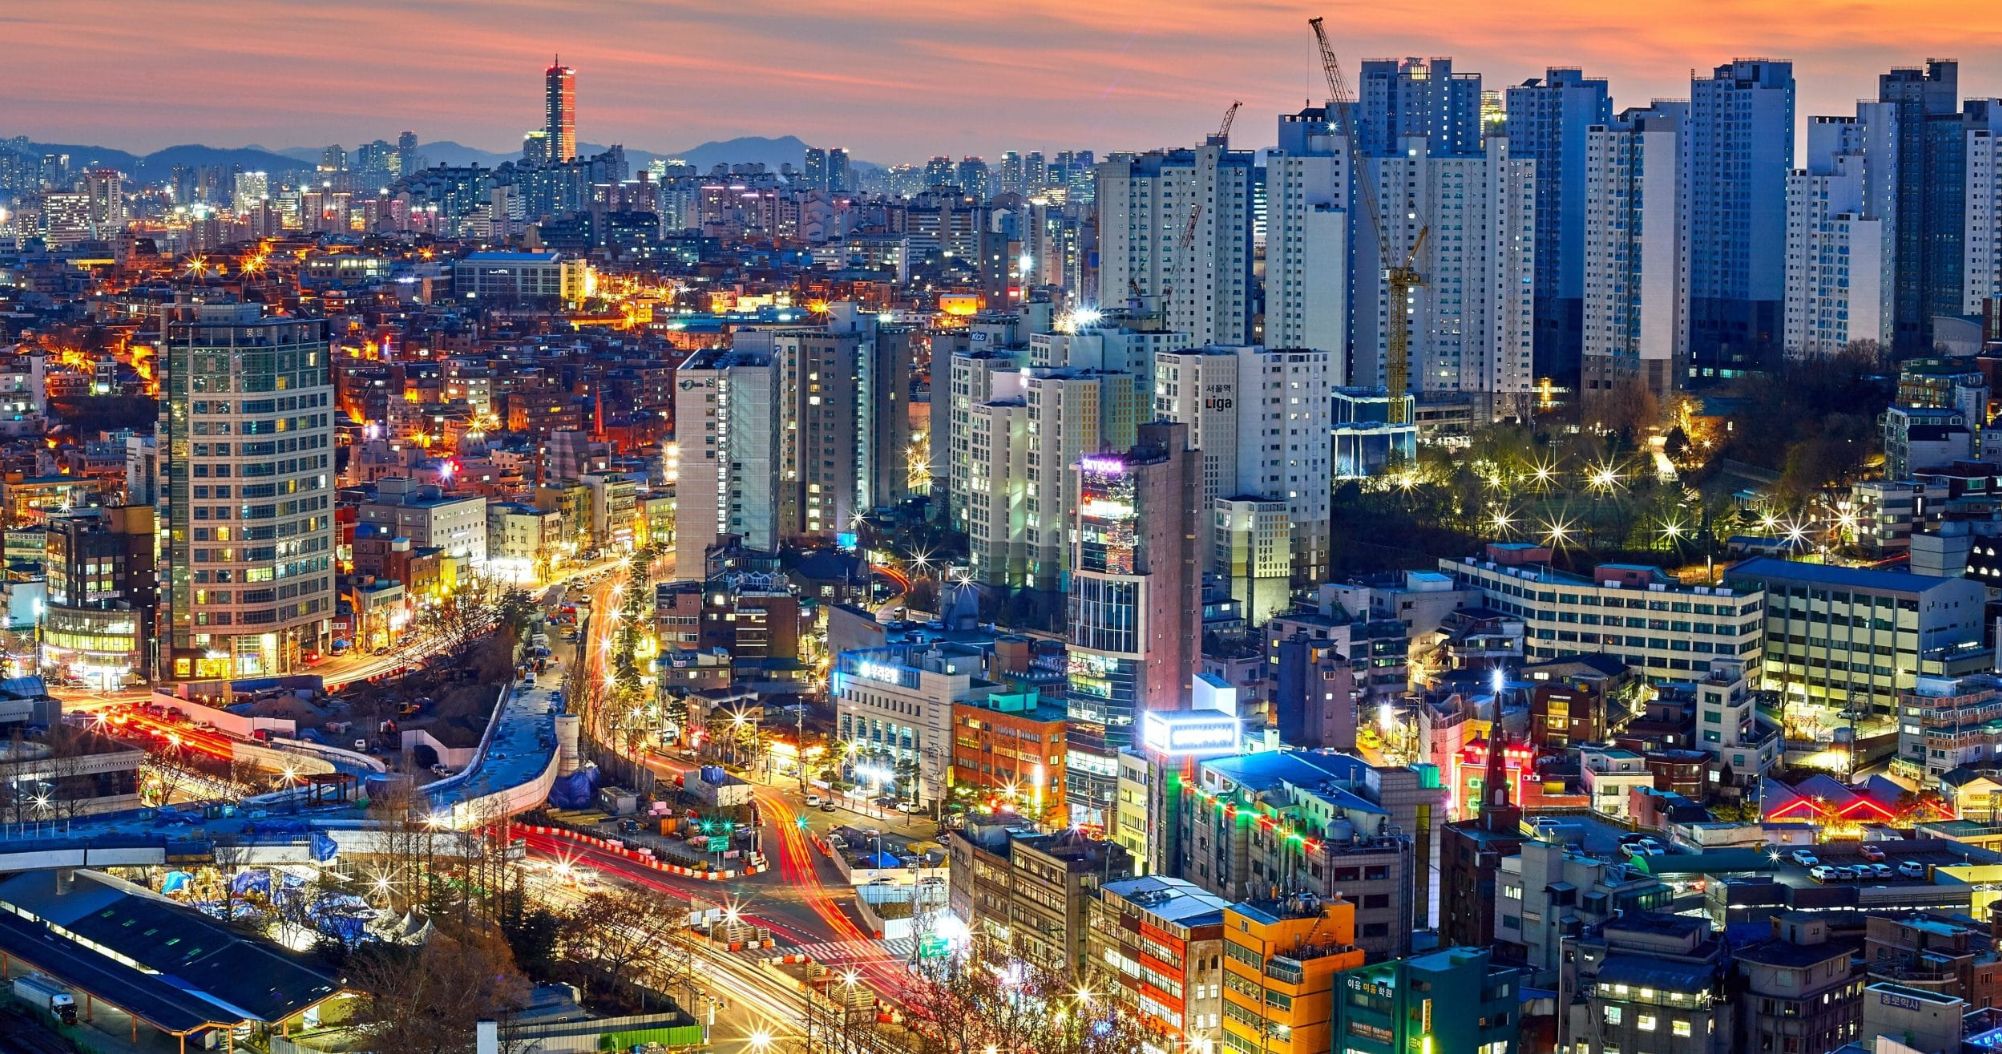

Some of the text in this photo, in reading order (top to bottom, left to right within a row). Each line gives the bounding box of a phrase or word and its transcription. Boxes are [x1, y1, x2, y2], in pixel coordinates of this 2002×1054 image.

[971, 332, 985, 340] KCC
[1206, 384, 1231, 393] 서울역
[1206, 395, 1232, 412] Liga
[870, 664, 899, 684] 우리은행
[1378, 987, 1393, 999] 학원
